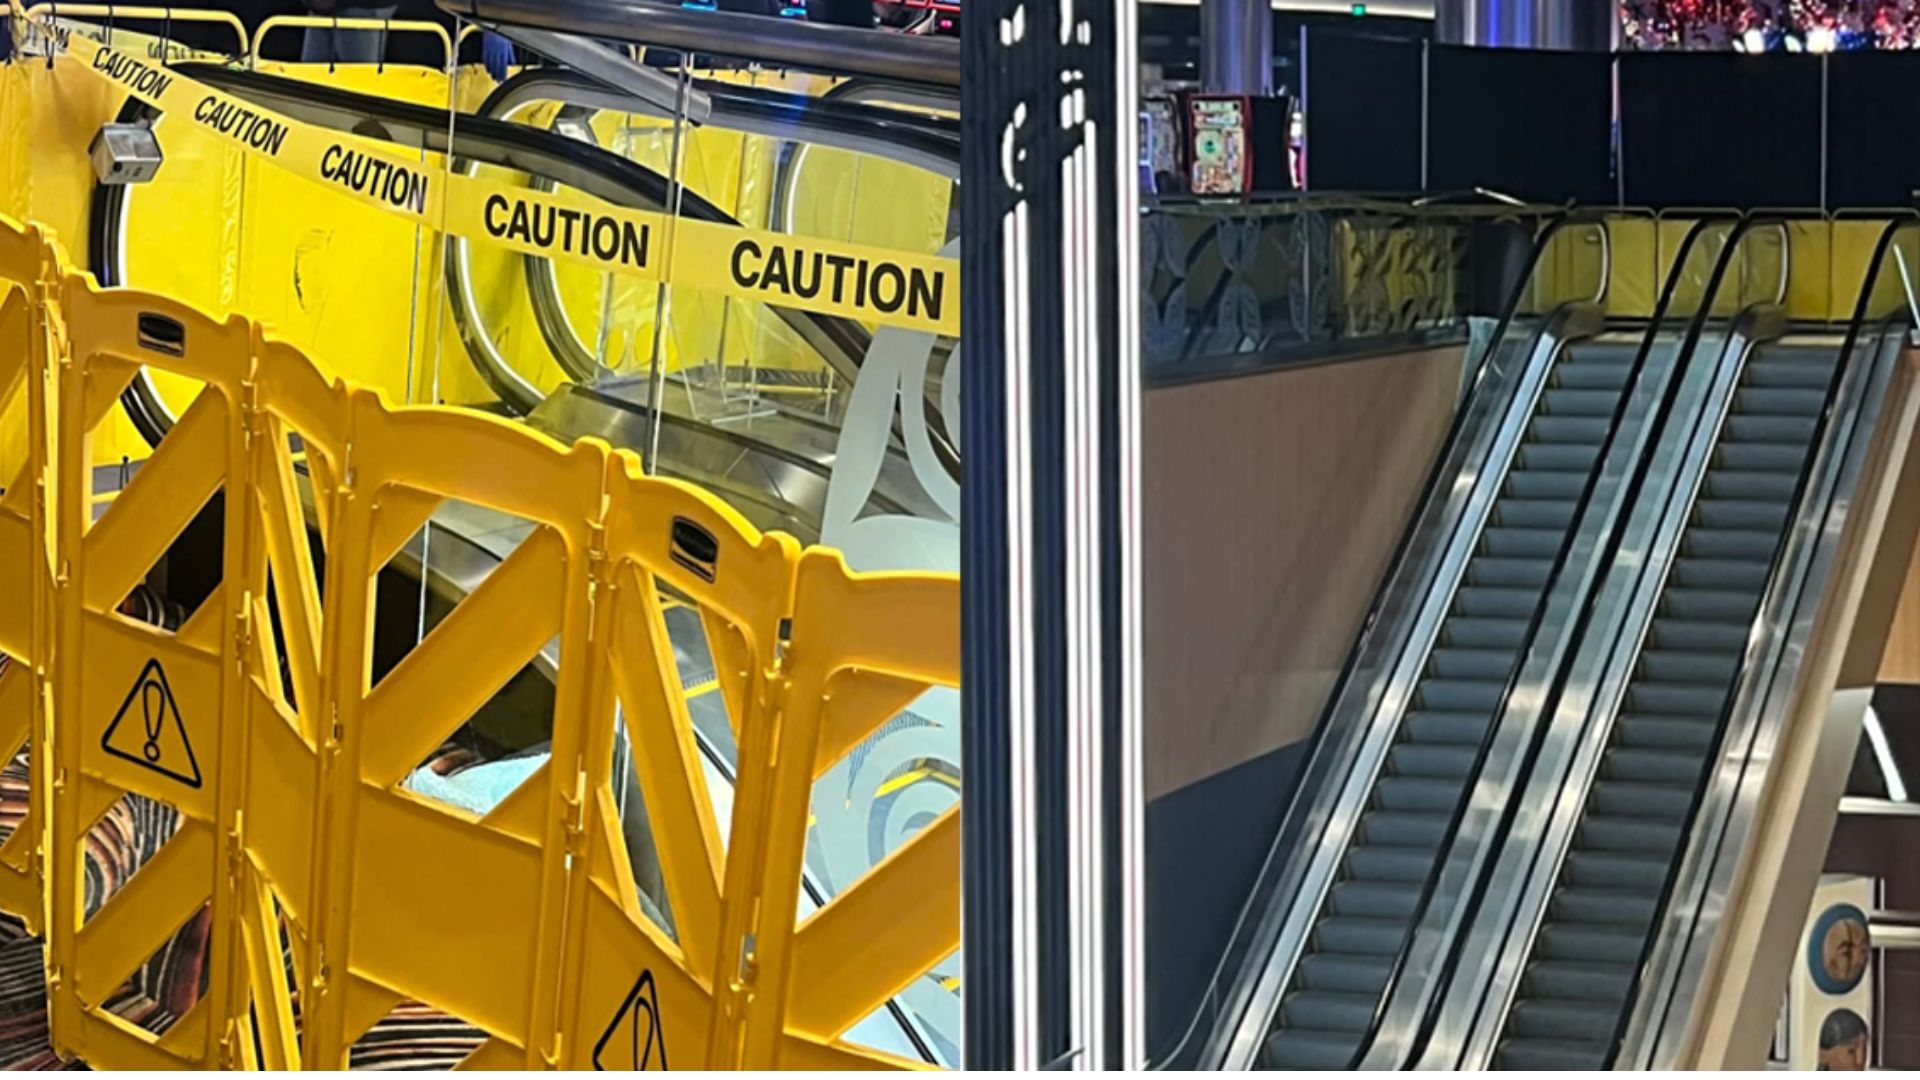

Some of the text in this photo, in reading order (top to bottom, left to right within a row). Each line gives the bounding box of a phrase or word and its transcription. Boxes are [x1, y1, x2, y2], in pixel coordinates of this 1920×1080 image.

[93, 47, 944, 320] CAUTION CAUTION CAUTION CAUTION CAUTION
